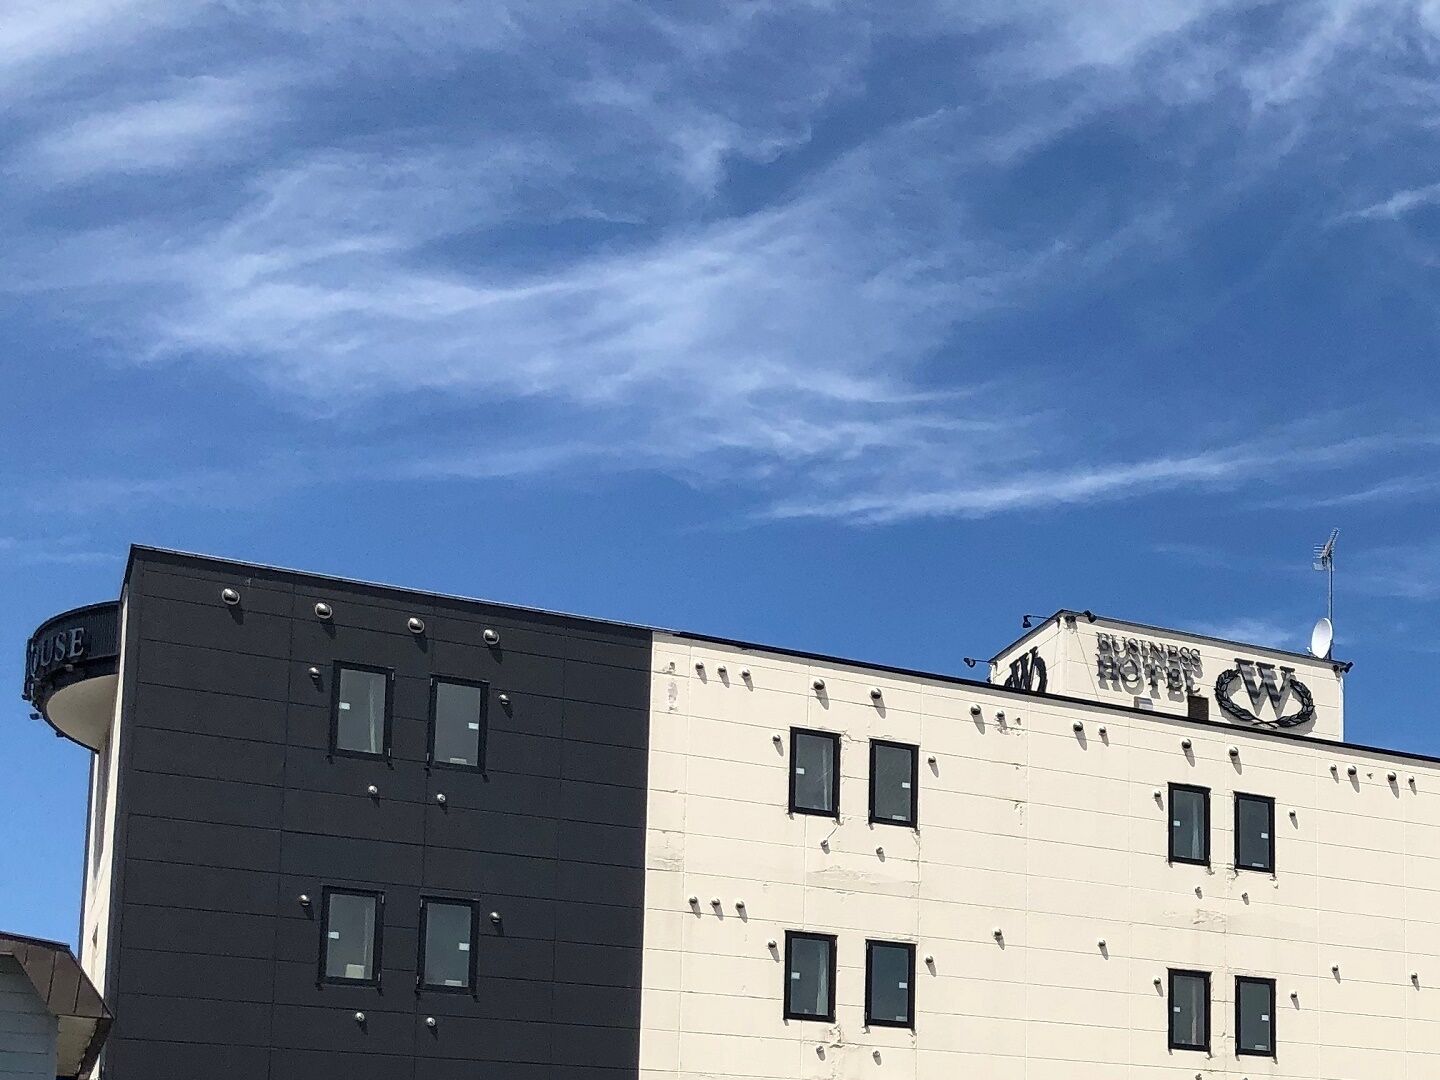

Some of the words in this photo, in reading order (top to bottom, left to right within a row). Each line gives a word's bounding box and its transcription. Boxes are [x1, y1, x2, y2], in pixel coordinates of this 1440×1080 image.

[1096, 631, 1201, 668] BUSINESS
[1095, 654, 1201, 696] HOTEL
[1234, 658, 1295, 710] W
